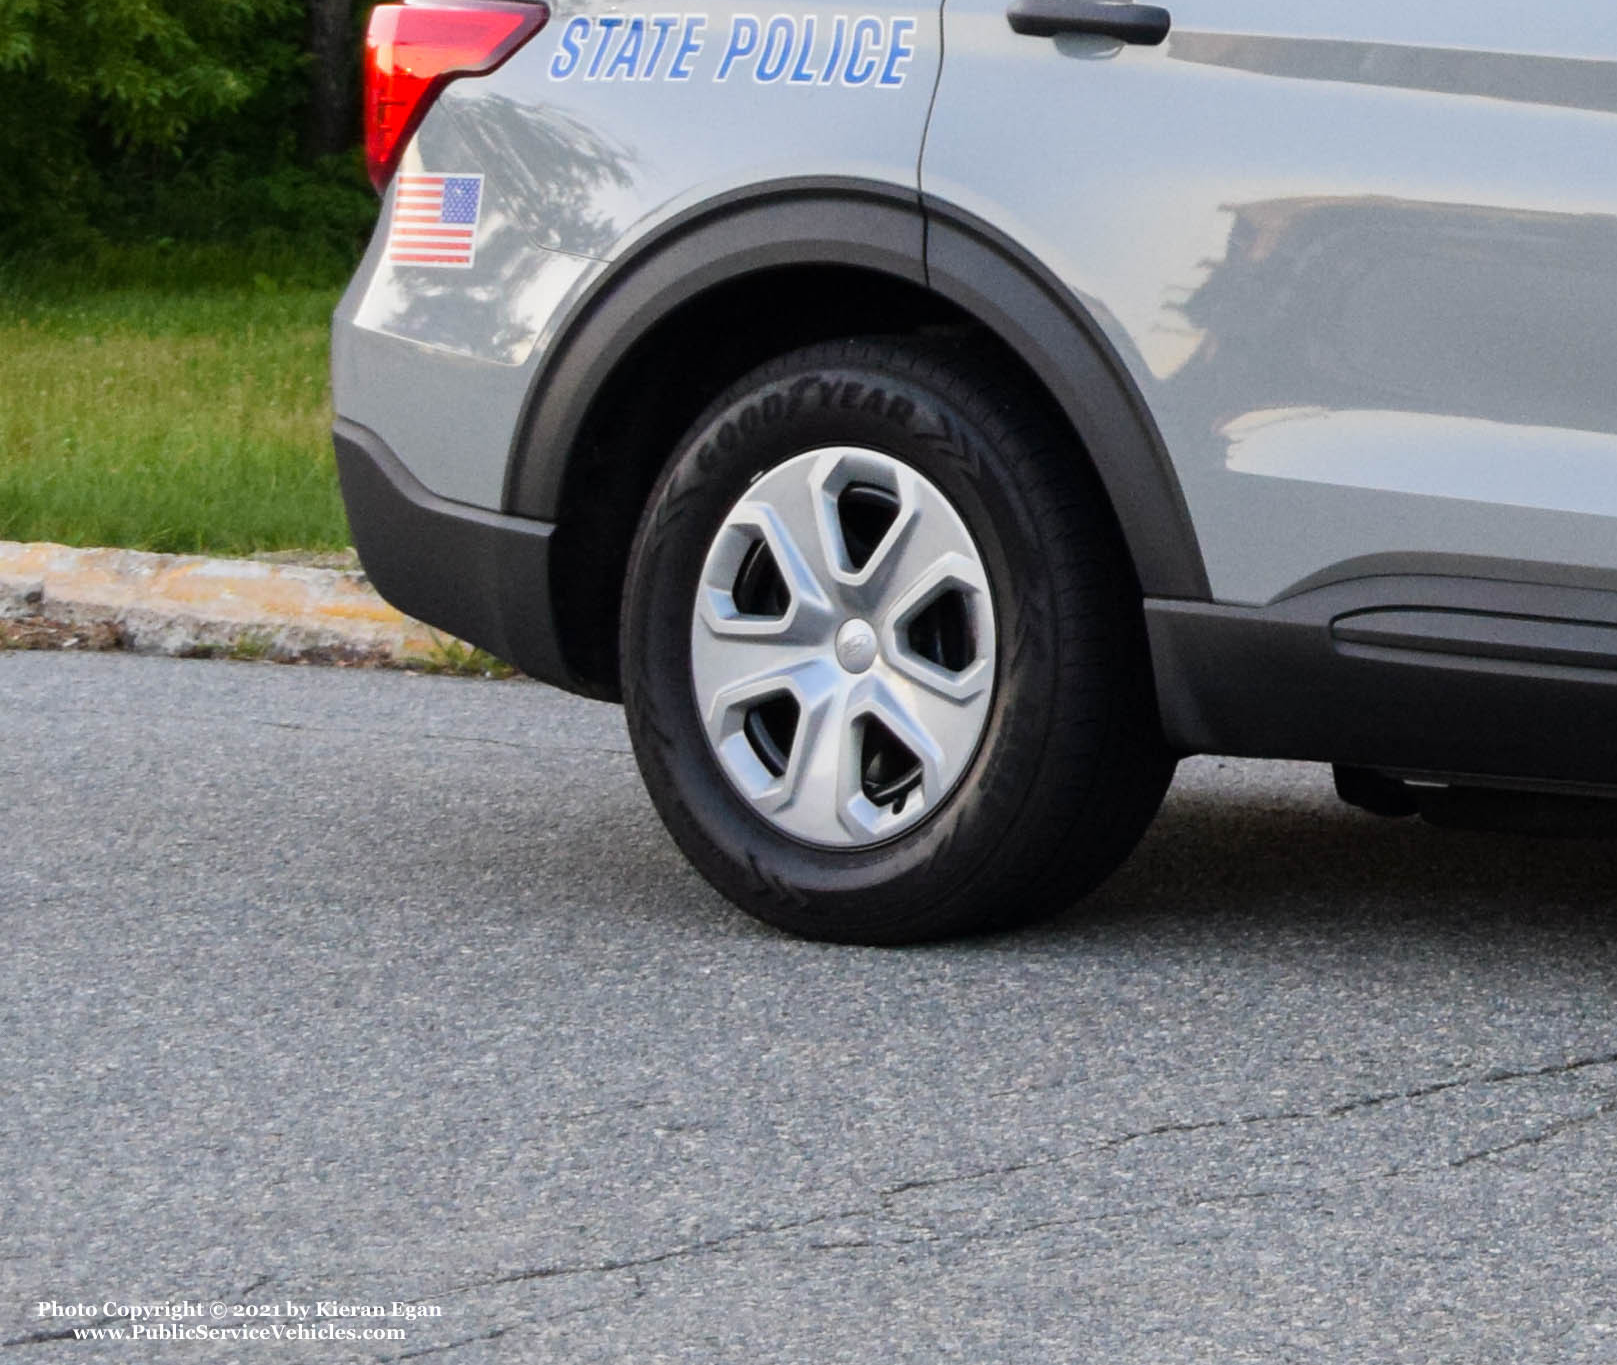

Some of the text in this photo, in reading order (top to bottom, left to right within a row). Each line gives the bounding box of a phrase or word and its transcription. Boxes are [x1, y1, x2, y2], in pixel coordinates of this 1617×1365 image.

[549, 14, 917, 88] STATE POLICE
[695, 374, 917, 474] GOODYEAR
